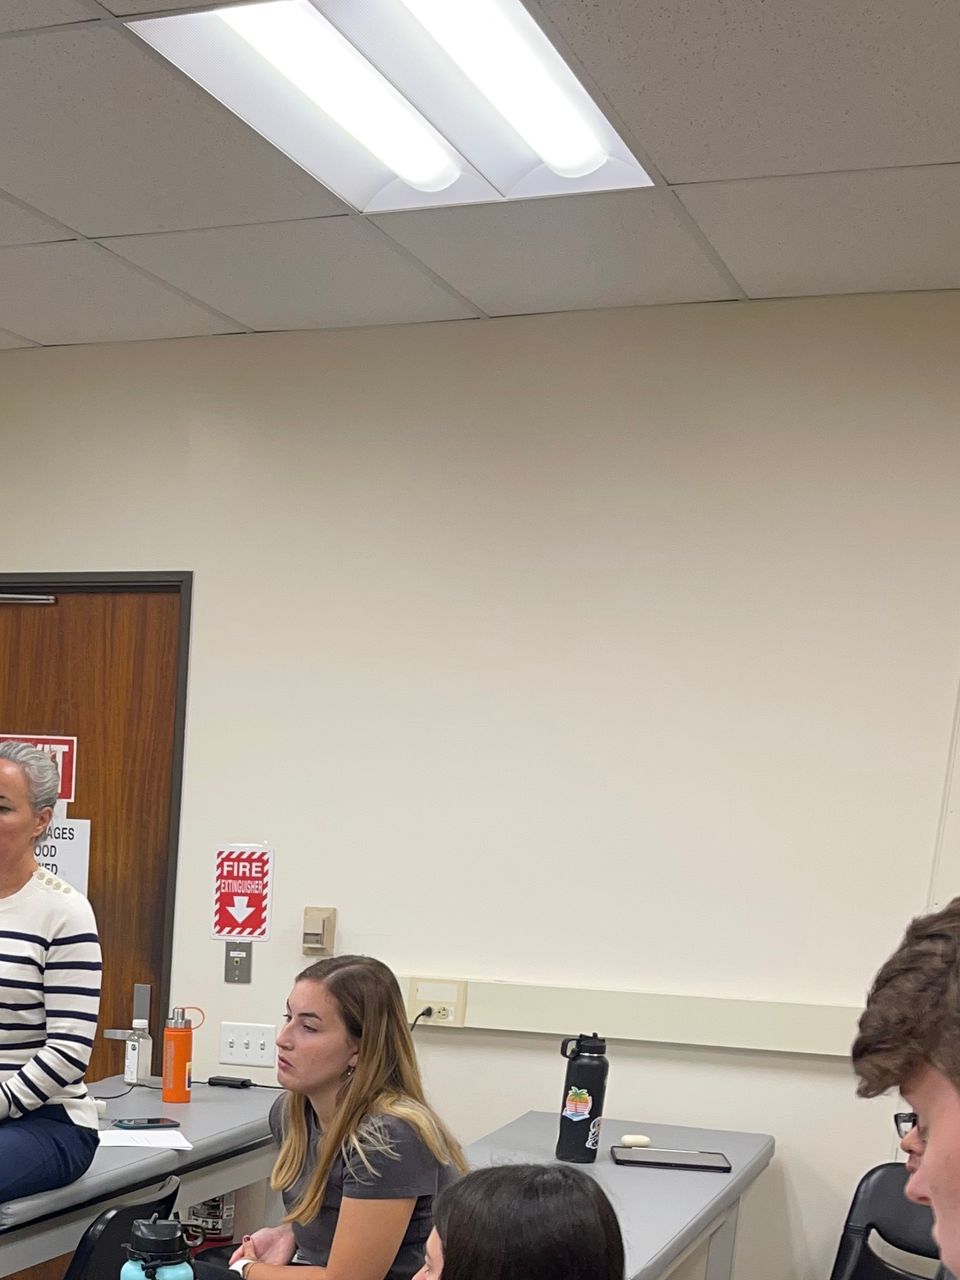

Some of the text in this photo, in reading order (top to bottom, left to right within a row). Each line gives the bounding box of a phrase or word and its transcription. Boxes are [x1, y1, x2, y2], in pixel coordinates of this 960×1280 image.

[47, 826, 75, 841] AGES
[34, 845, 57, 858] OOD
[222, 861, 262, 877] FIRE
[220, 879, 263, 893] EXTINGUISHER
